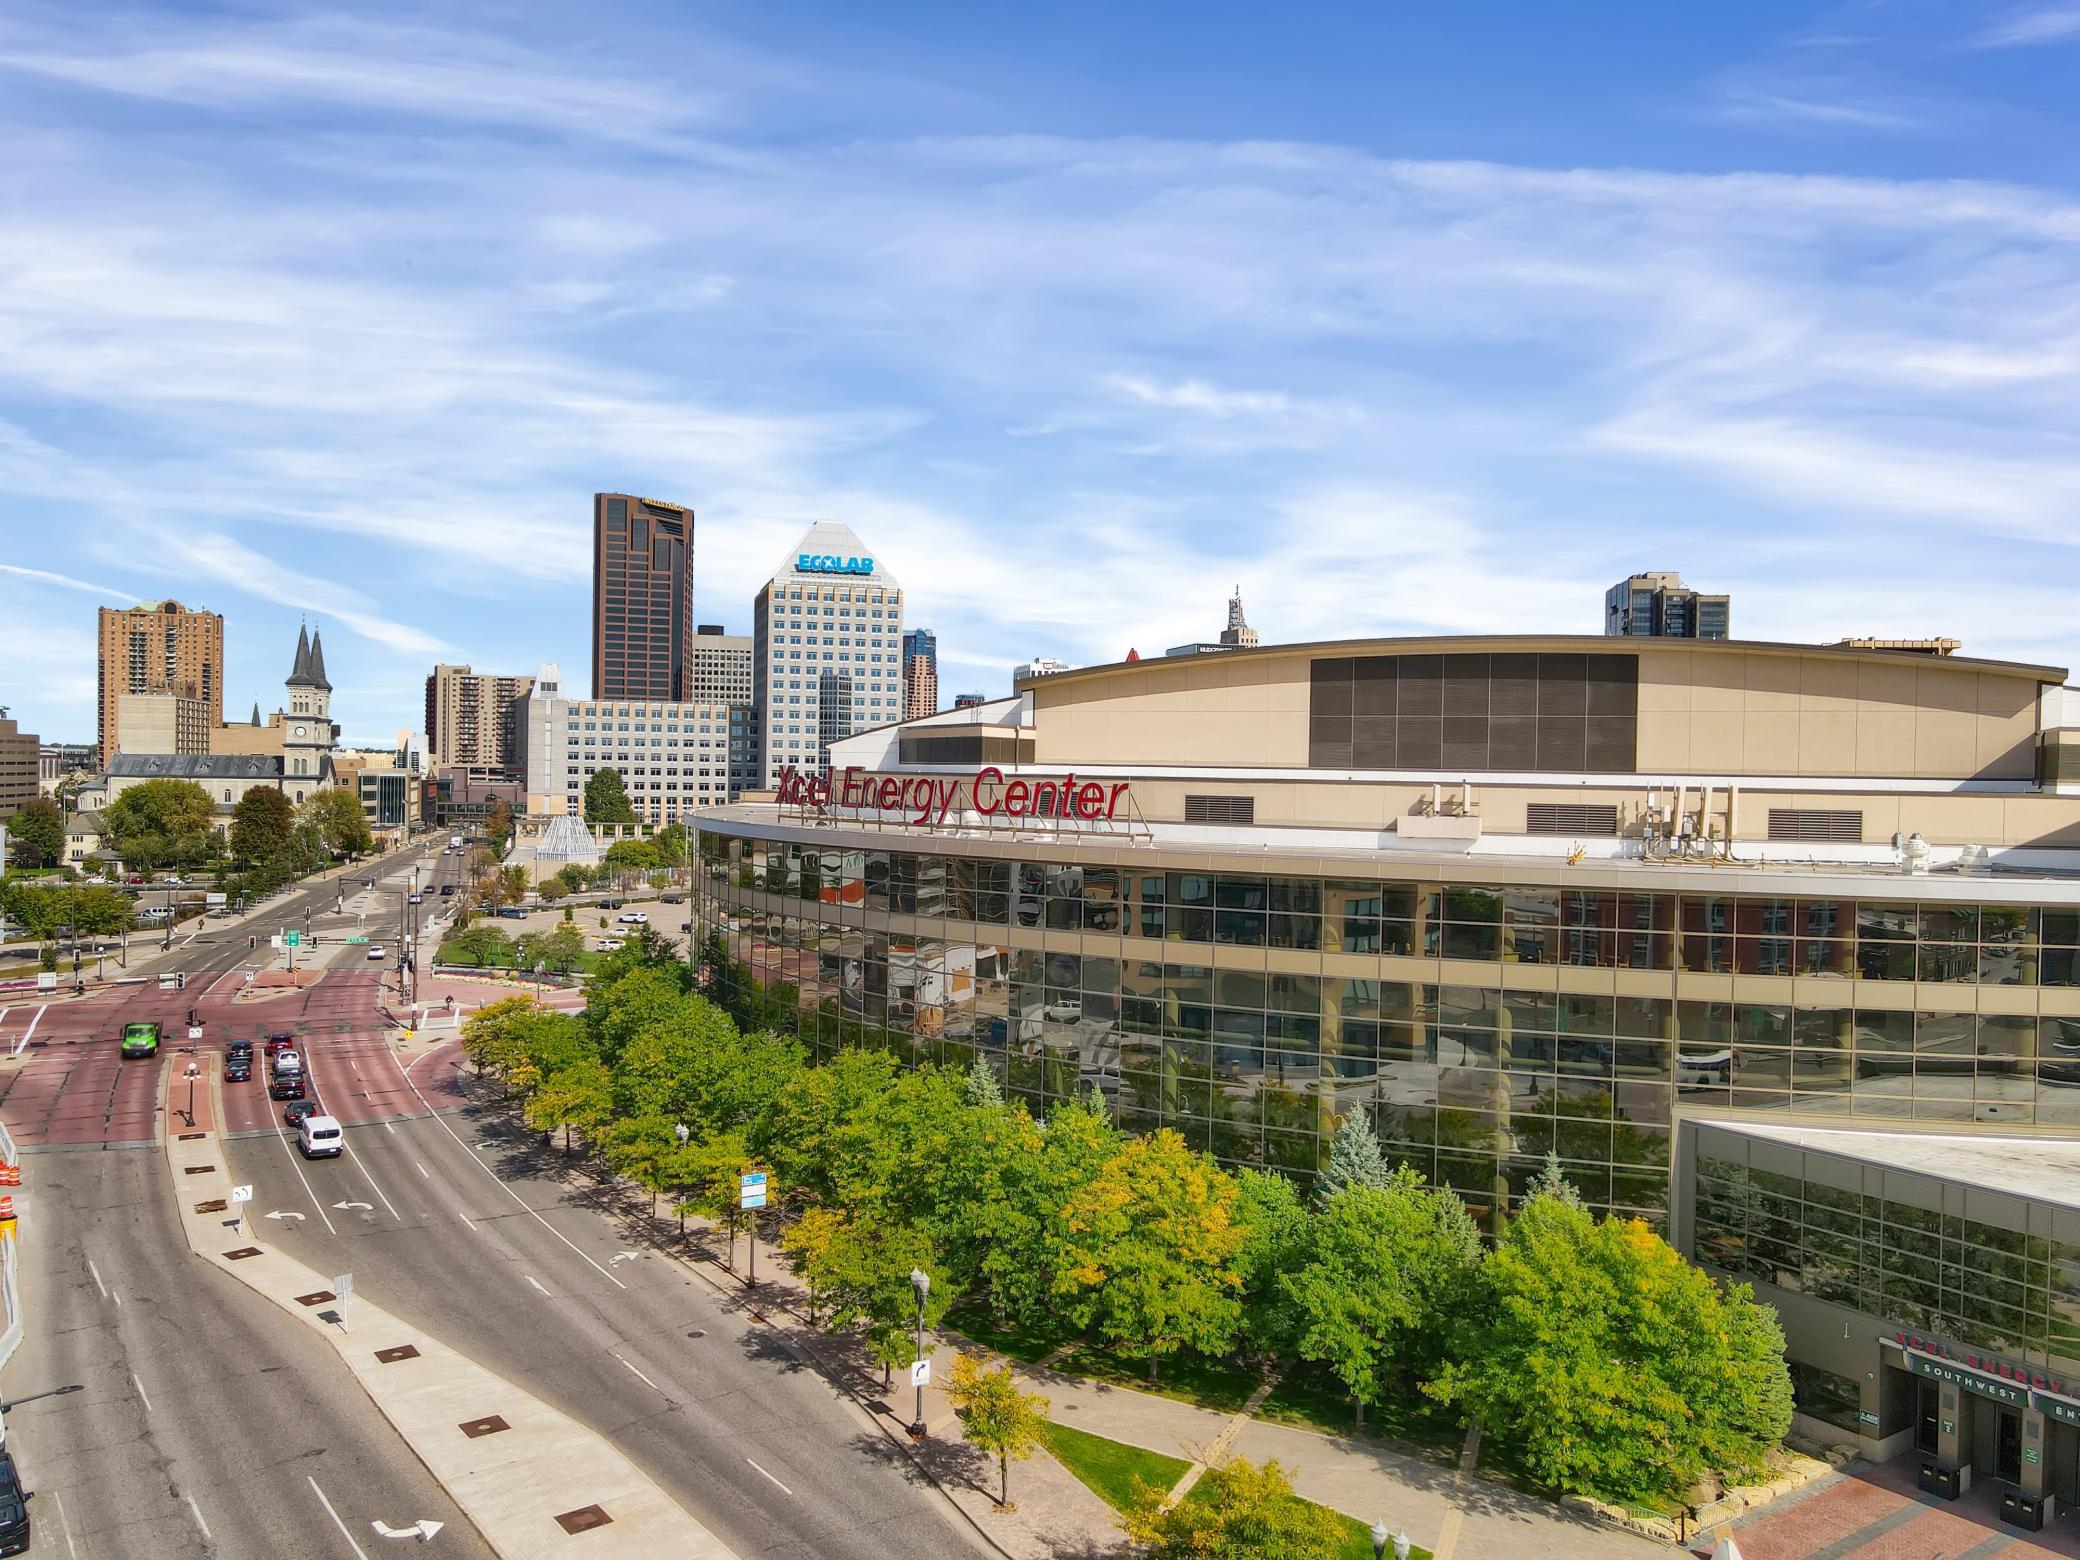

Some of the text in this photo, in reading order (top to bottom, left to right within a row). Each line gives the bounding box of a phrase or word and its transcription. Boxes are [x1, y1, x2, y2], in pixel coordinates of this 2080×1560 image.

[798, 554, 875, 573] ECOLAB
[774, 764, 1131, 826] Xcel Energy Center
[1922, 1362, 2018, 1401] SOUTHWEST
